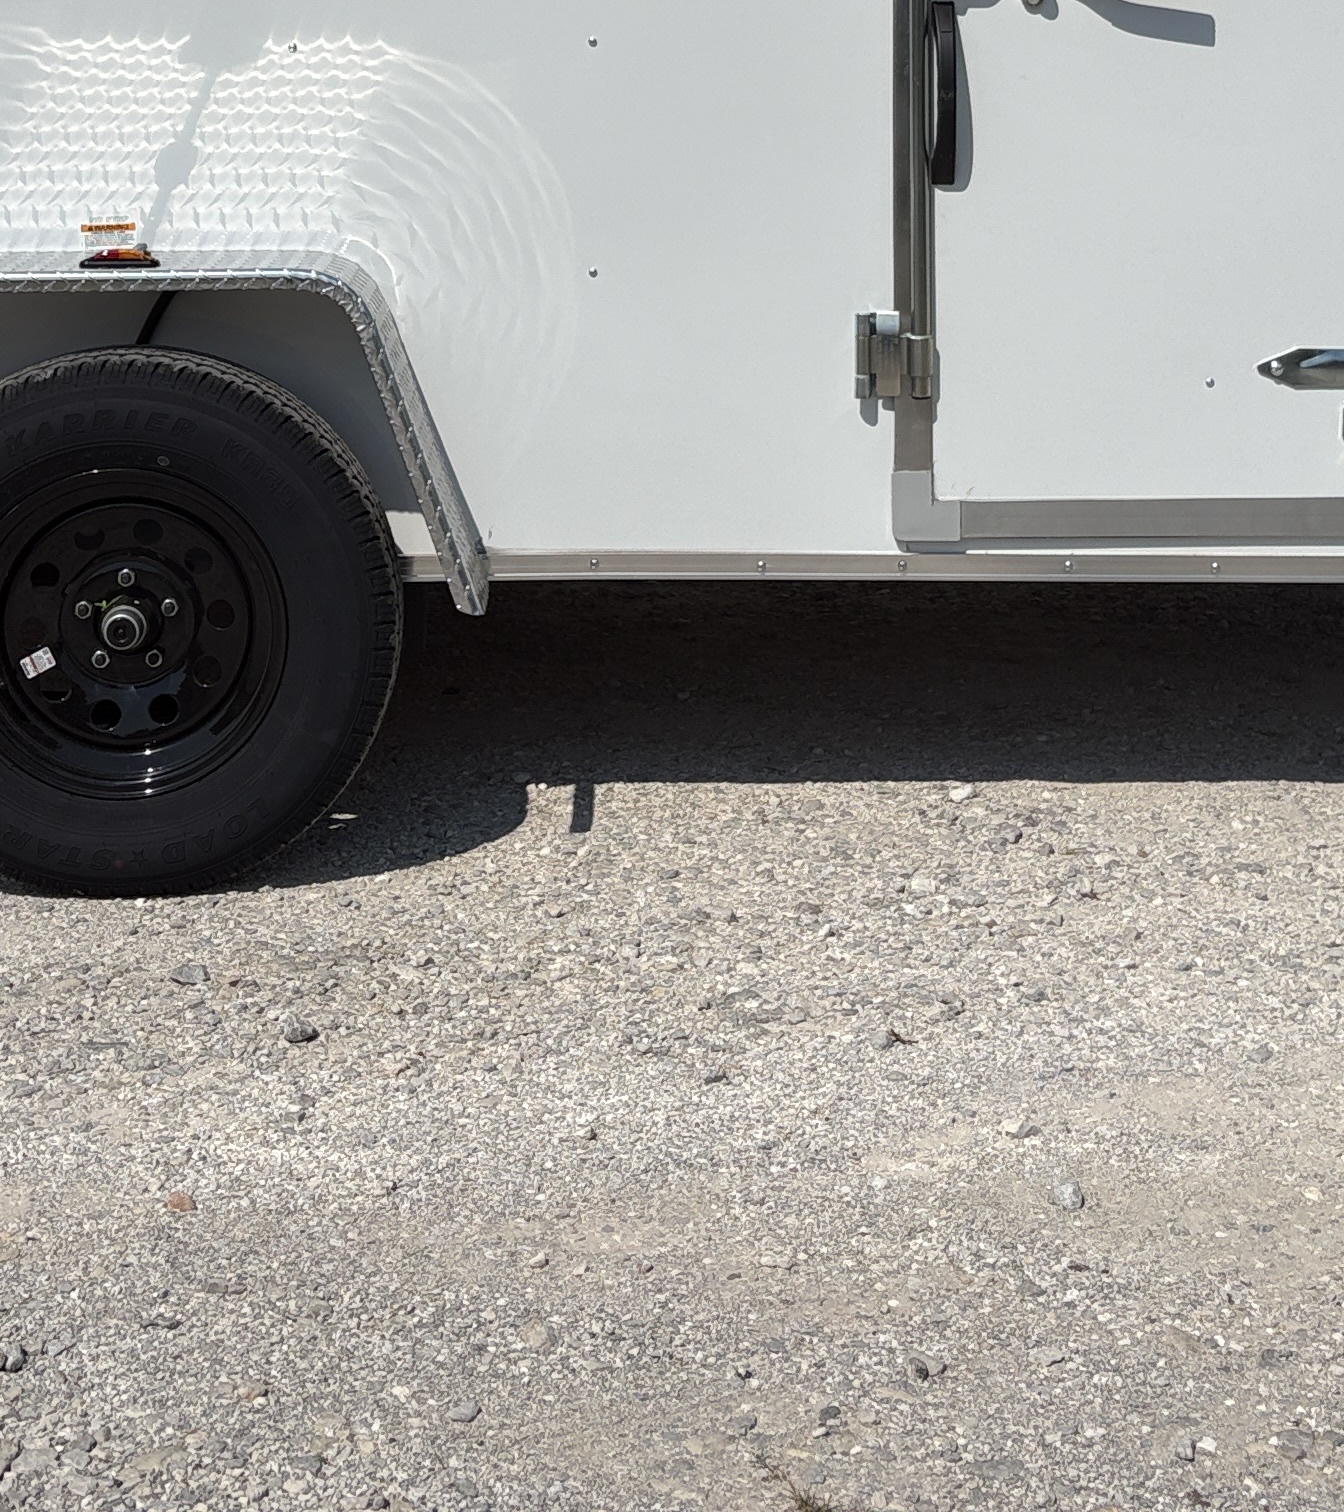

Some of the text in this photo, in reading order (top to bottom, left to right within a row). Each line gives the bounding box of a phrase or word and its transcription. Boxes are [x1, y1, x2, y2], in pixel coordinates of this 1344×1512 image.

[4, 408, 201, 457] KARRIER
[0, 798, 273, 872] LOAD STAR
